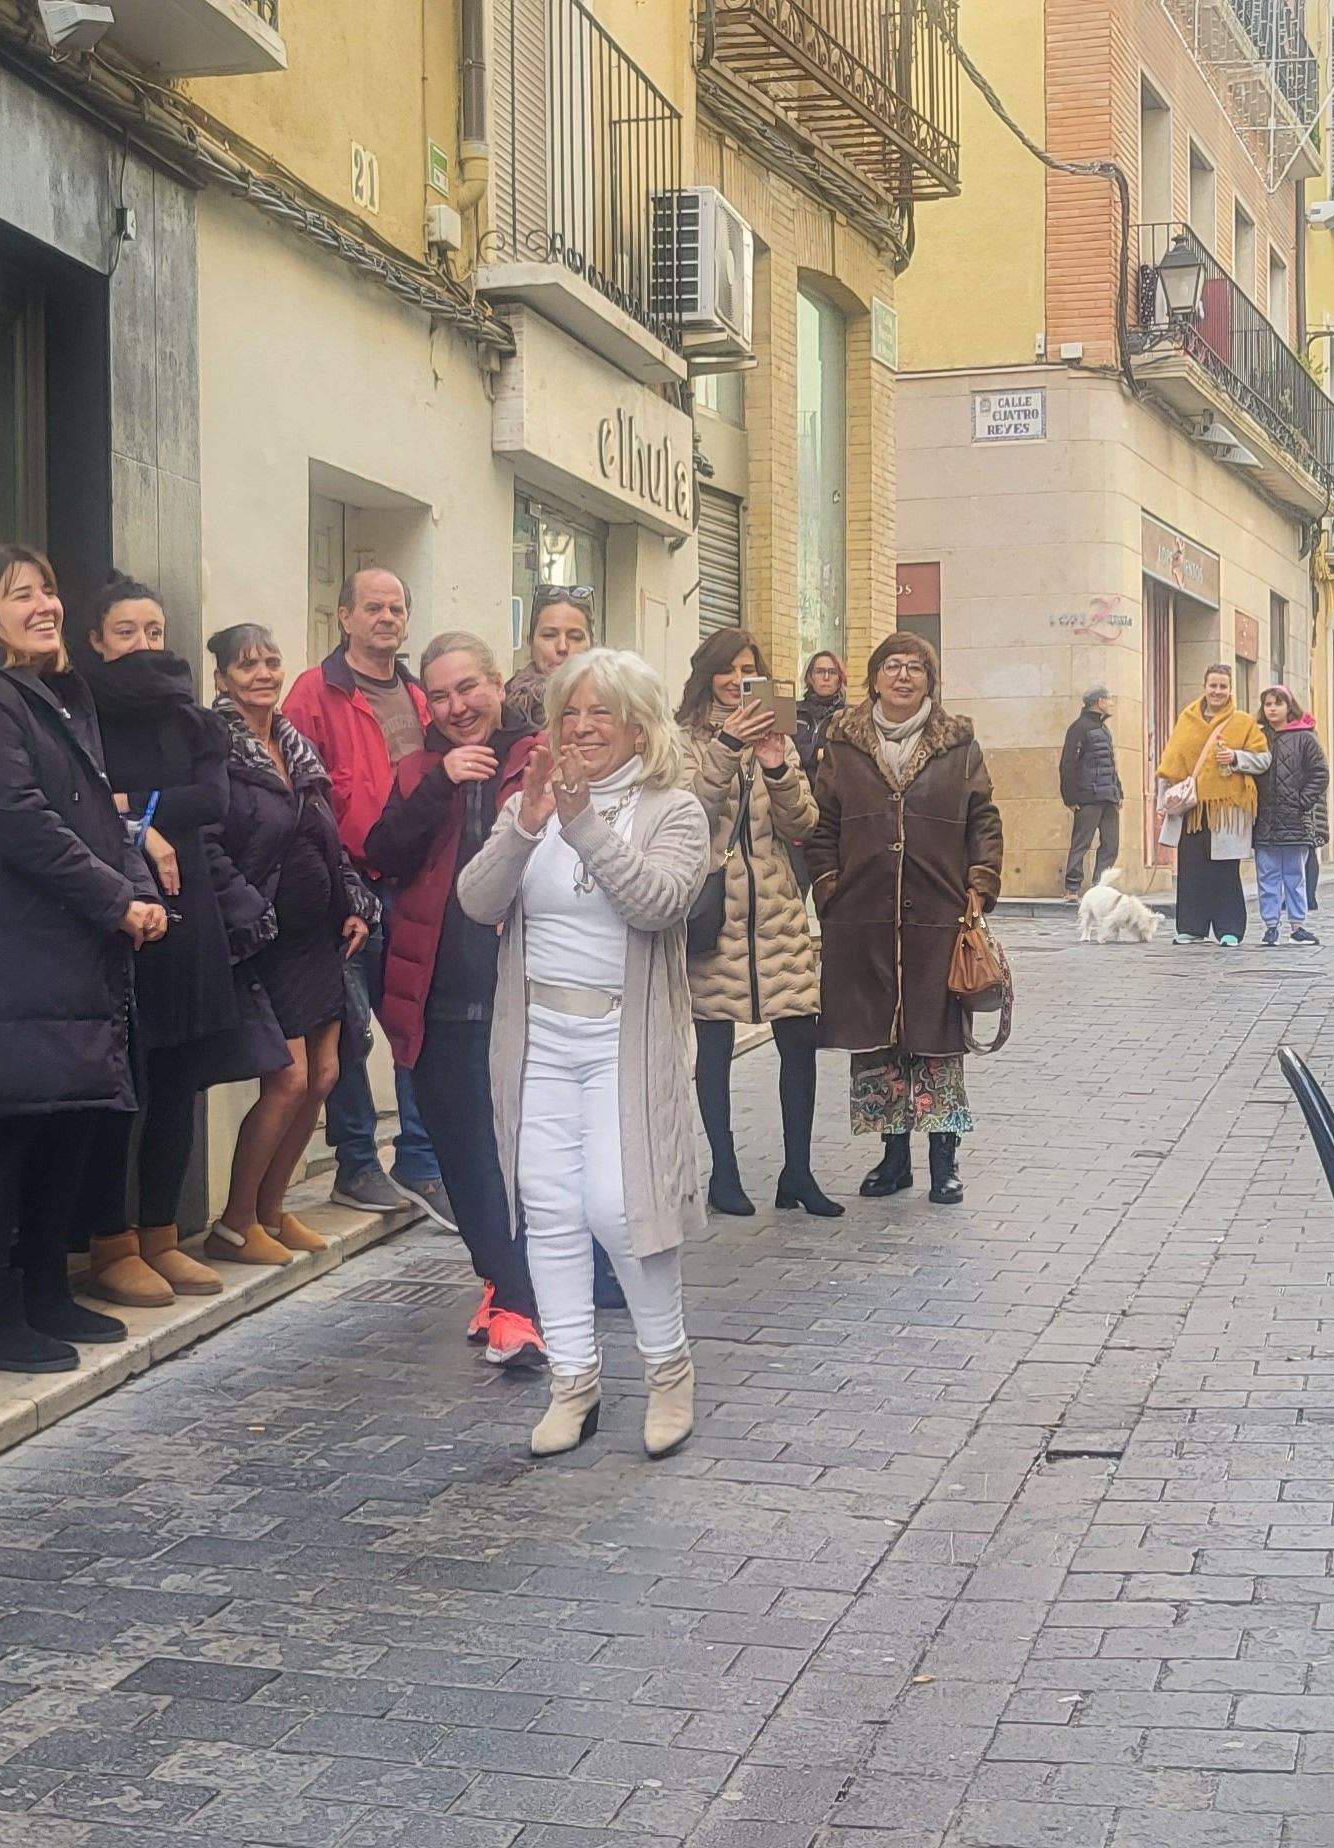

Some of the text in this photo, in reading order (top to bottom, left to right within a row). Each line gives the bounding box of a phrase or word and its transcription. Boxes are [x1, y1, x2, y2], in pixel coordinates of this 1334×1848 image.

[353, 148, 377, 210] 21
[997, 396, 1032, 408] CALLE
[992, 409, 1039, 421] CUATRO
[987, 423, 1030, 436] REYES
